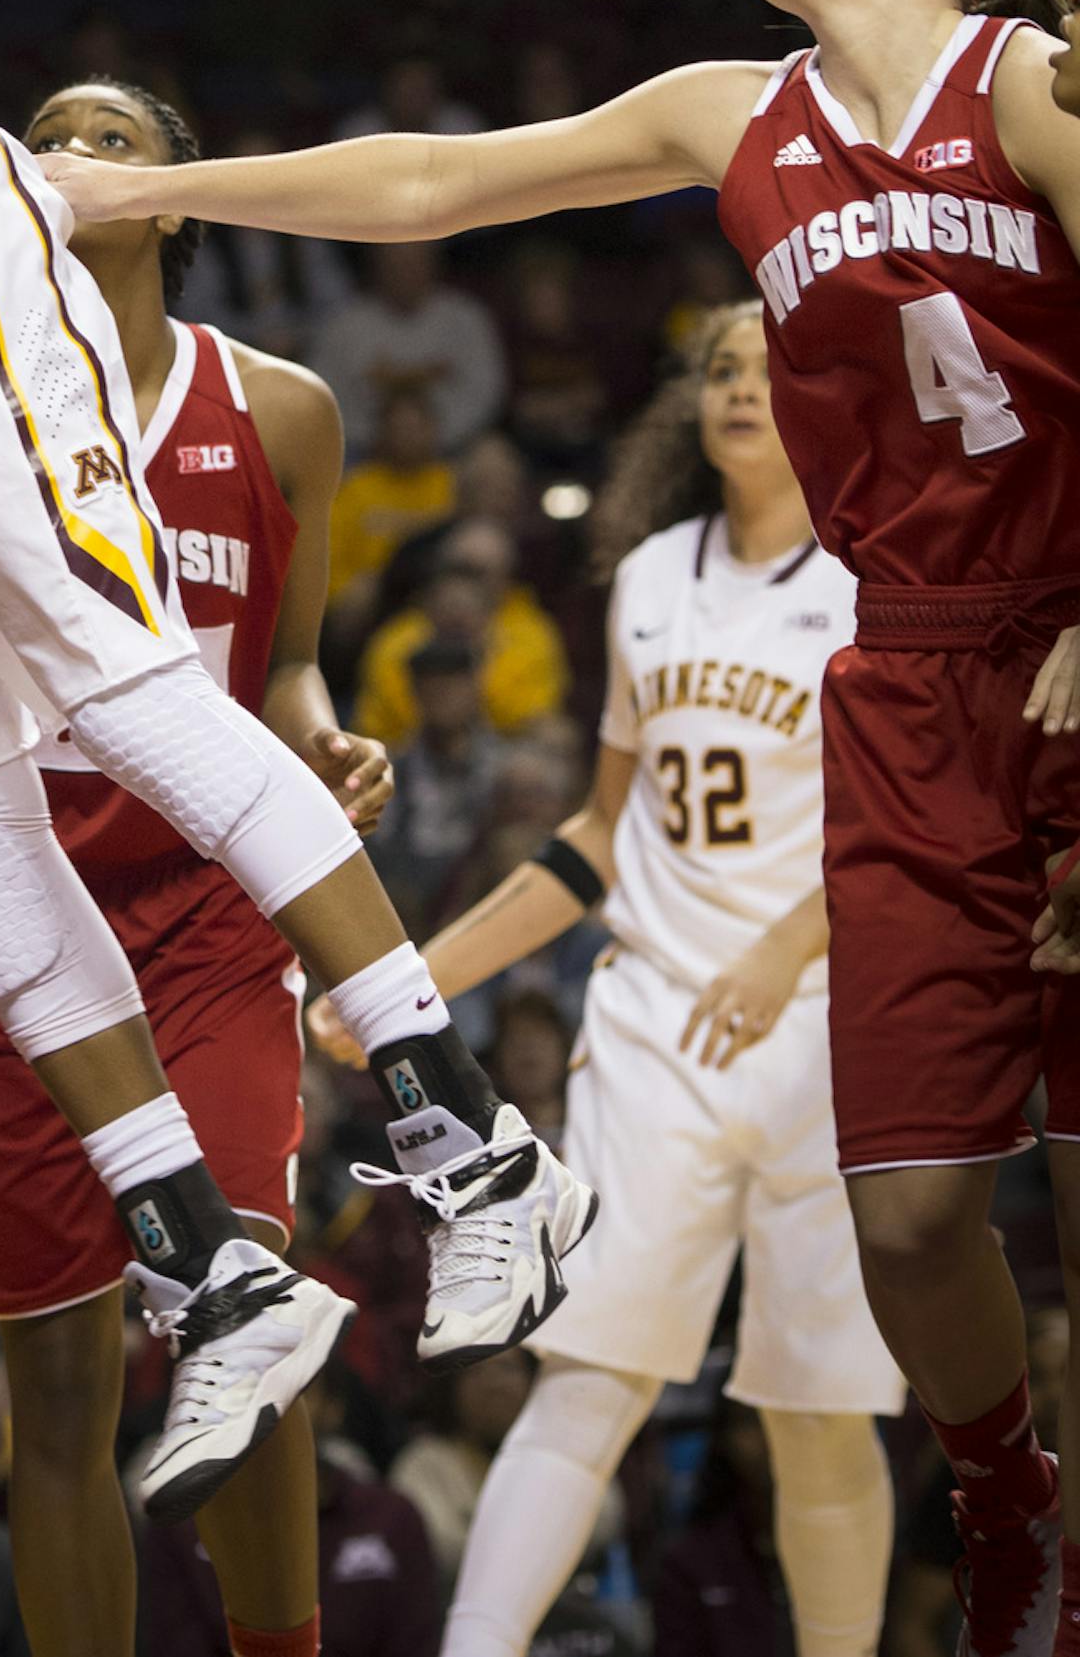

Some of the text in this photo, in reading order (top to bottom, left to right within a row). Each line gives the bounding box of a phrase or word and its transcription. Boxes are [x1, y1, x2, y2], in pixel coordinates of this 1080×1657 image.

[755, 189, 1042, 326] WISCONSIN
[899, 290, 1027, 457] 4
[655, 745, 756, 850] 32
